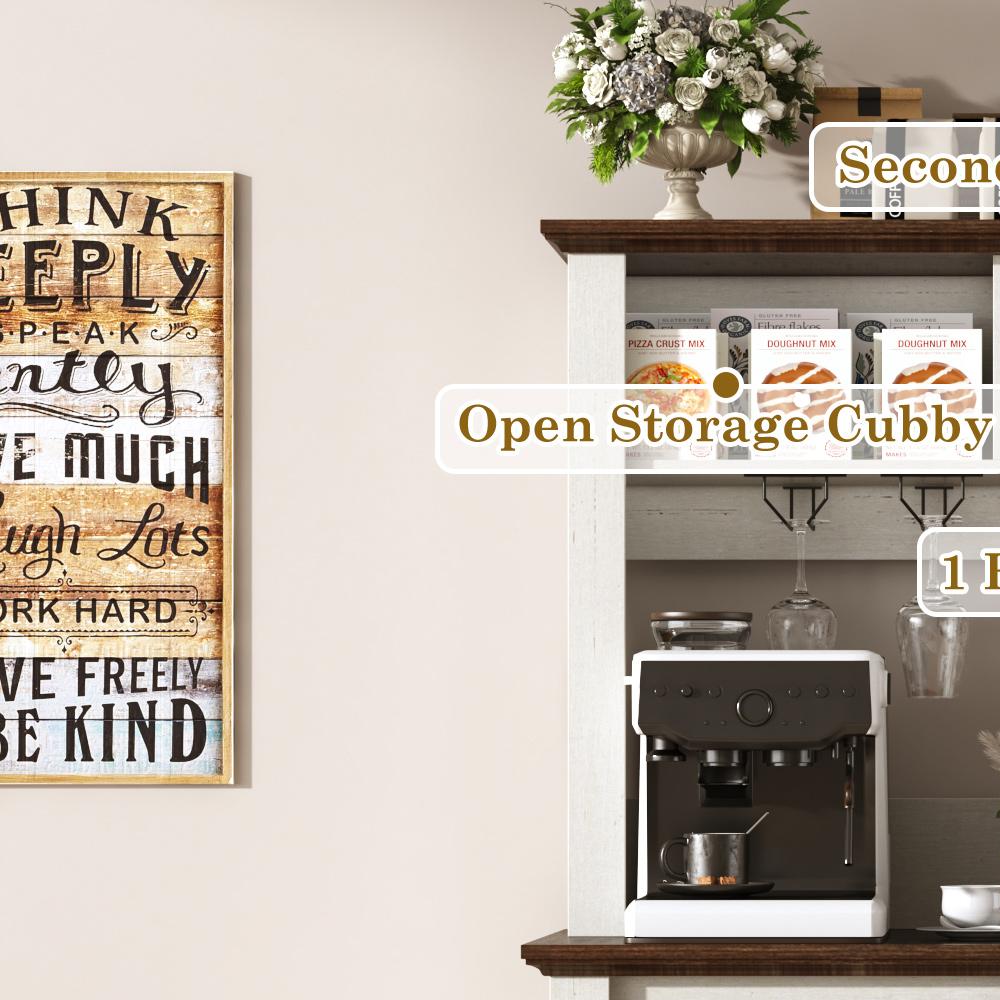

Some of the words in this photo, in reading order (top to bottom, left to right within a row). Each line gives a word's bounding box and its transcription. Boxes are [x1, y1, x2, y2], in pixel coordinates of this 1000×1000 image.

[628, 340, 653, 348] PIZZA
[655, 340, 684, 348] CRUST
[688, 340, 705, 348] MIX
[767, 340, 816, 348] DOUGHNUT
[819, 340, 836, 348] MIX
[898, 340, 947, 348] DOUGHNUT
[950, 340, 967, 348] MIX
[65, 432, 209, 504] MUCH
[97, 502, 209, 569] Lots
[75, 598, 178, 624] HARD
[77, 656, 204, 698] FREELY
[64, 697, 208, 763] KIND
